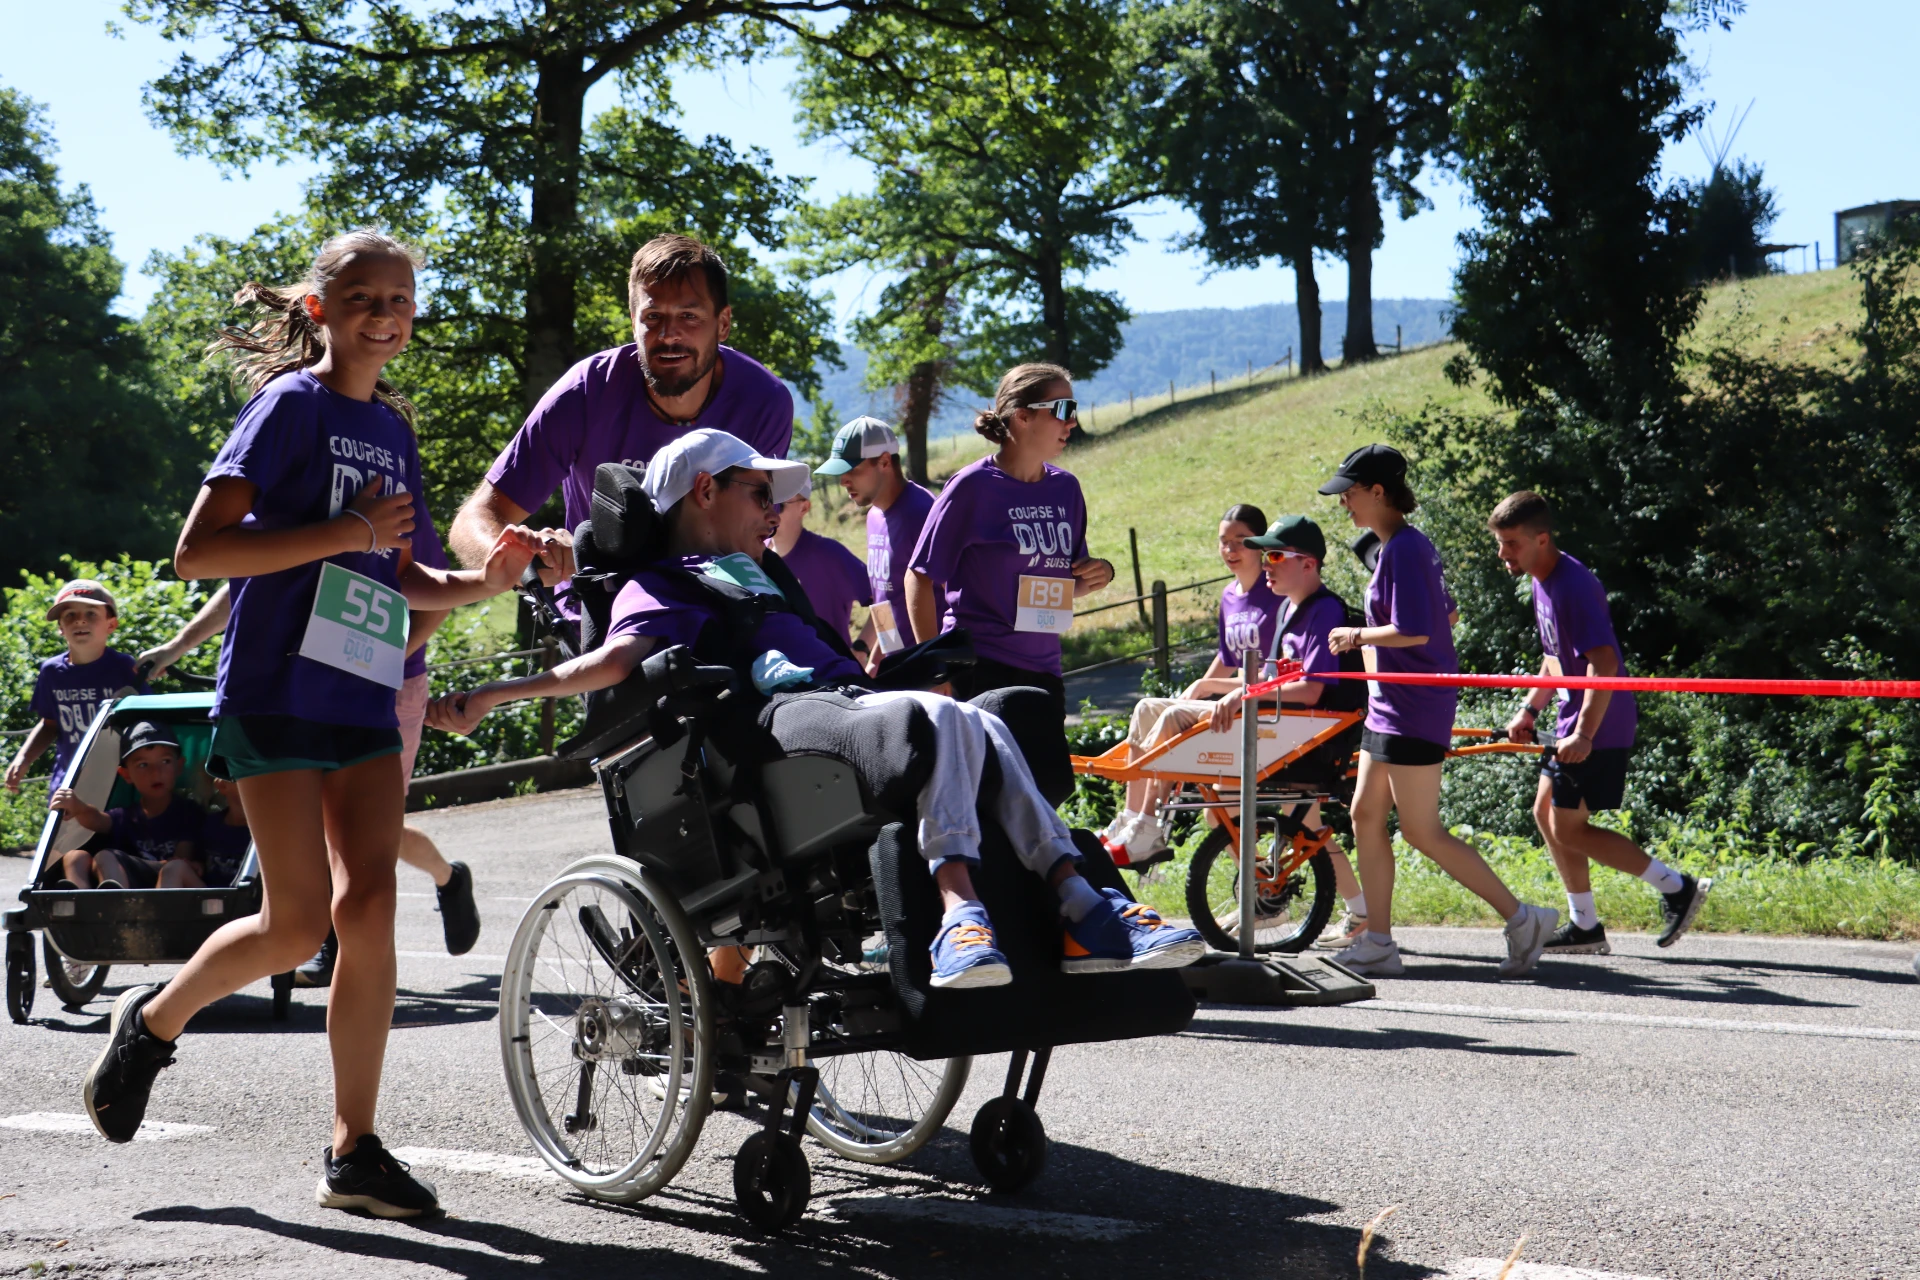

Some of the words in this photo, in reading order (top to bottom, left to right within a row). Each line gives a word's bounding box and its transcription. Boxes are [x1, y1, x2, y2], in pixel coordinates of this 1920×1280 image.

[329, 435, 395, 471] COURSE
[1008, 505, 1055, 520] COURSE
[1012, 521, 1073, 556] DUO
[1044, 557, 1072, 569] SUISS
[340, 578, 393, 635] 55
[1029, 580, 1064, 607] 139
[343, 637, 375, 664] DUO
[1225, 622, 1261, 652] DUO
[57, 703, 97, 733] DU
